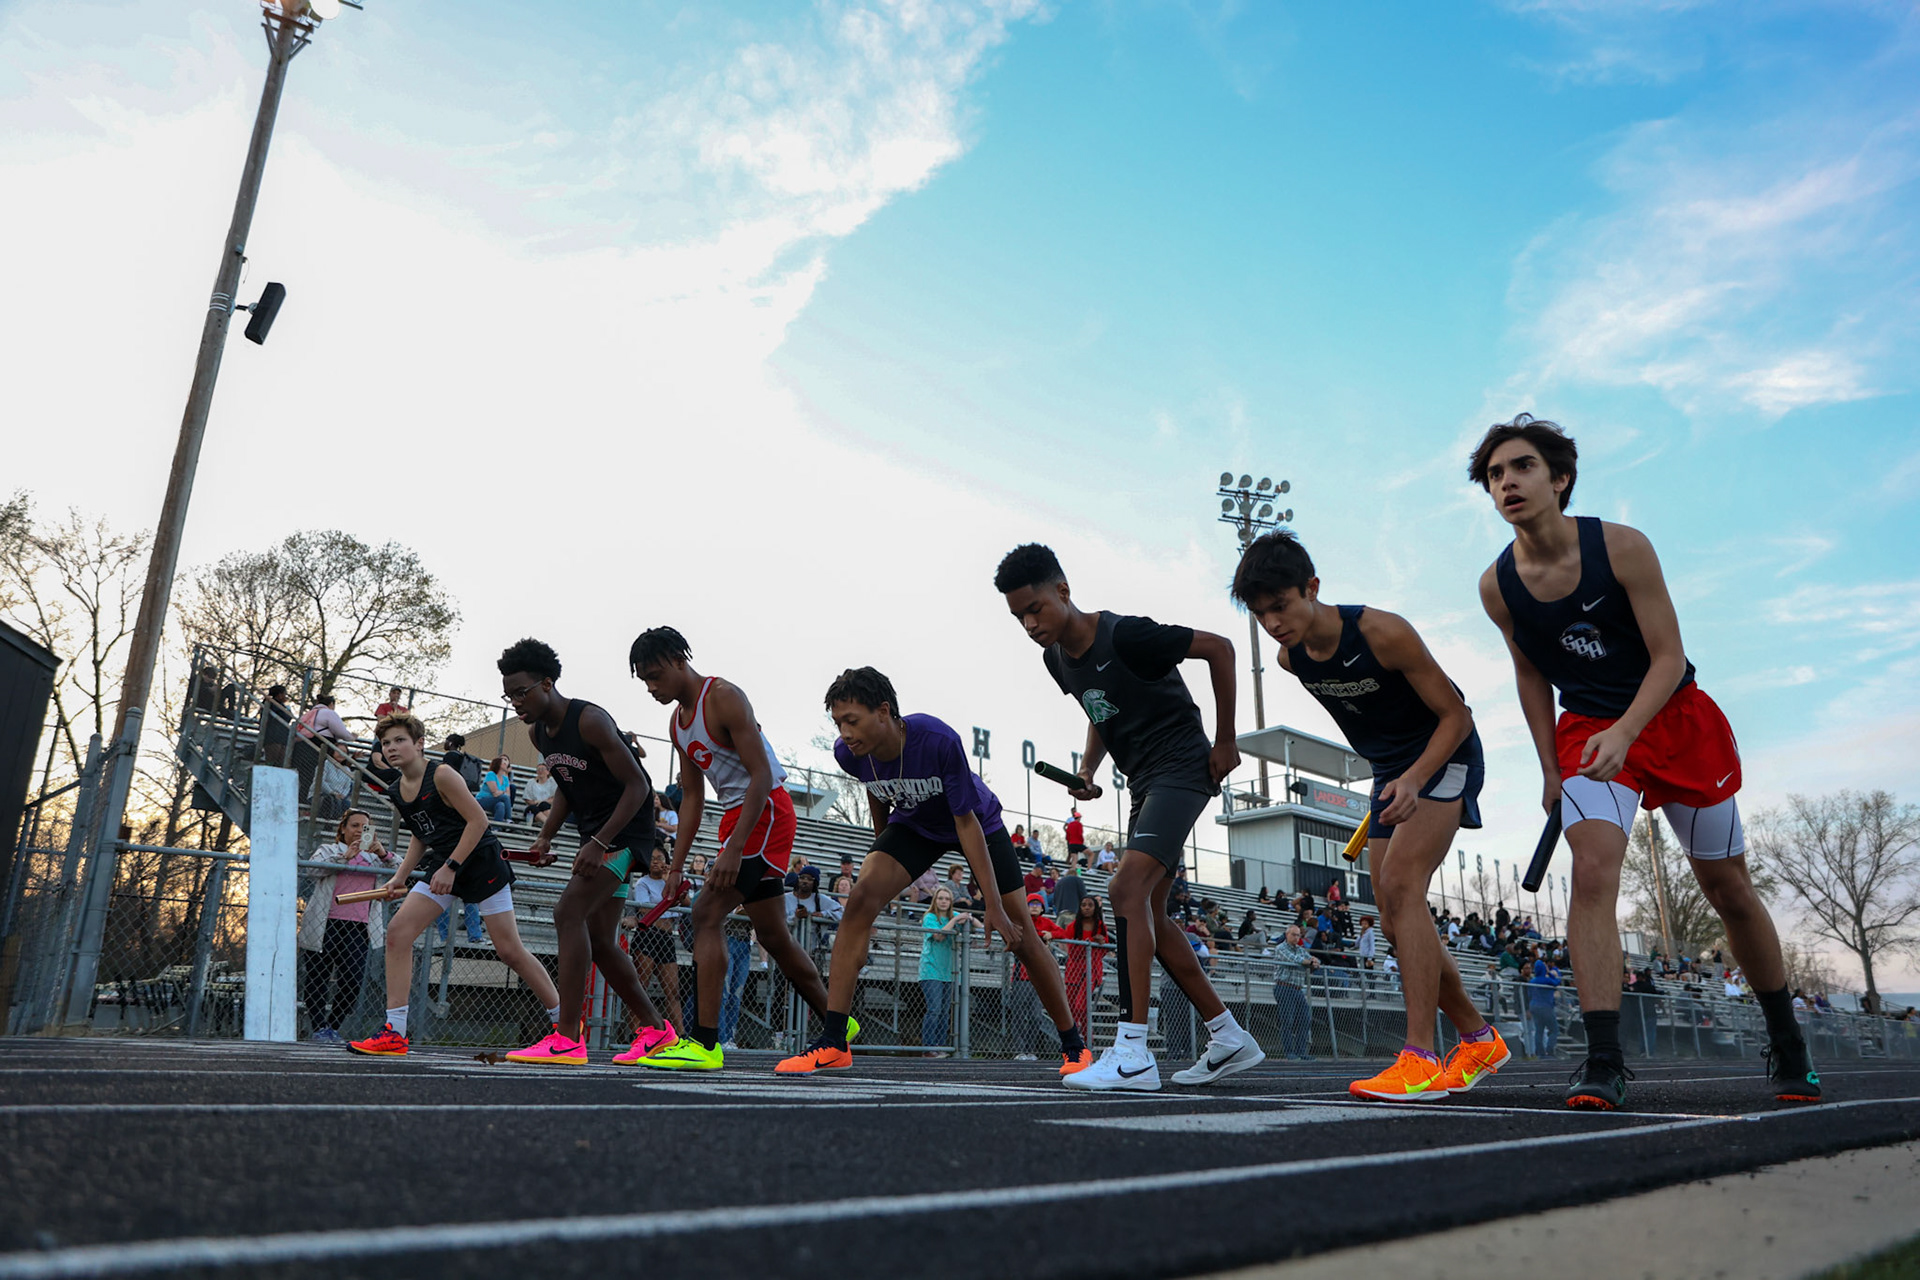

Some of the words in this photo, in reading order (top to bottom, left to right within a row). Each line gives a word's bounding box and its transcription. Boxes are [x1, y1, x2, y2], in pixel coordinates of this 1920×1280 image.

[1561, 634, 1604, 659] SBA
[545, 752, 588, 771] STANGS
[687, 740, 713, 770] G
[865, 776, 944, 799] OUTHWIND
[1313, 788, 1348, 808] LANDERS
[1344, 871, 1360, 898] H
